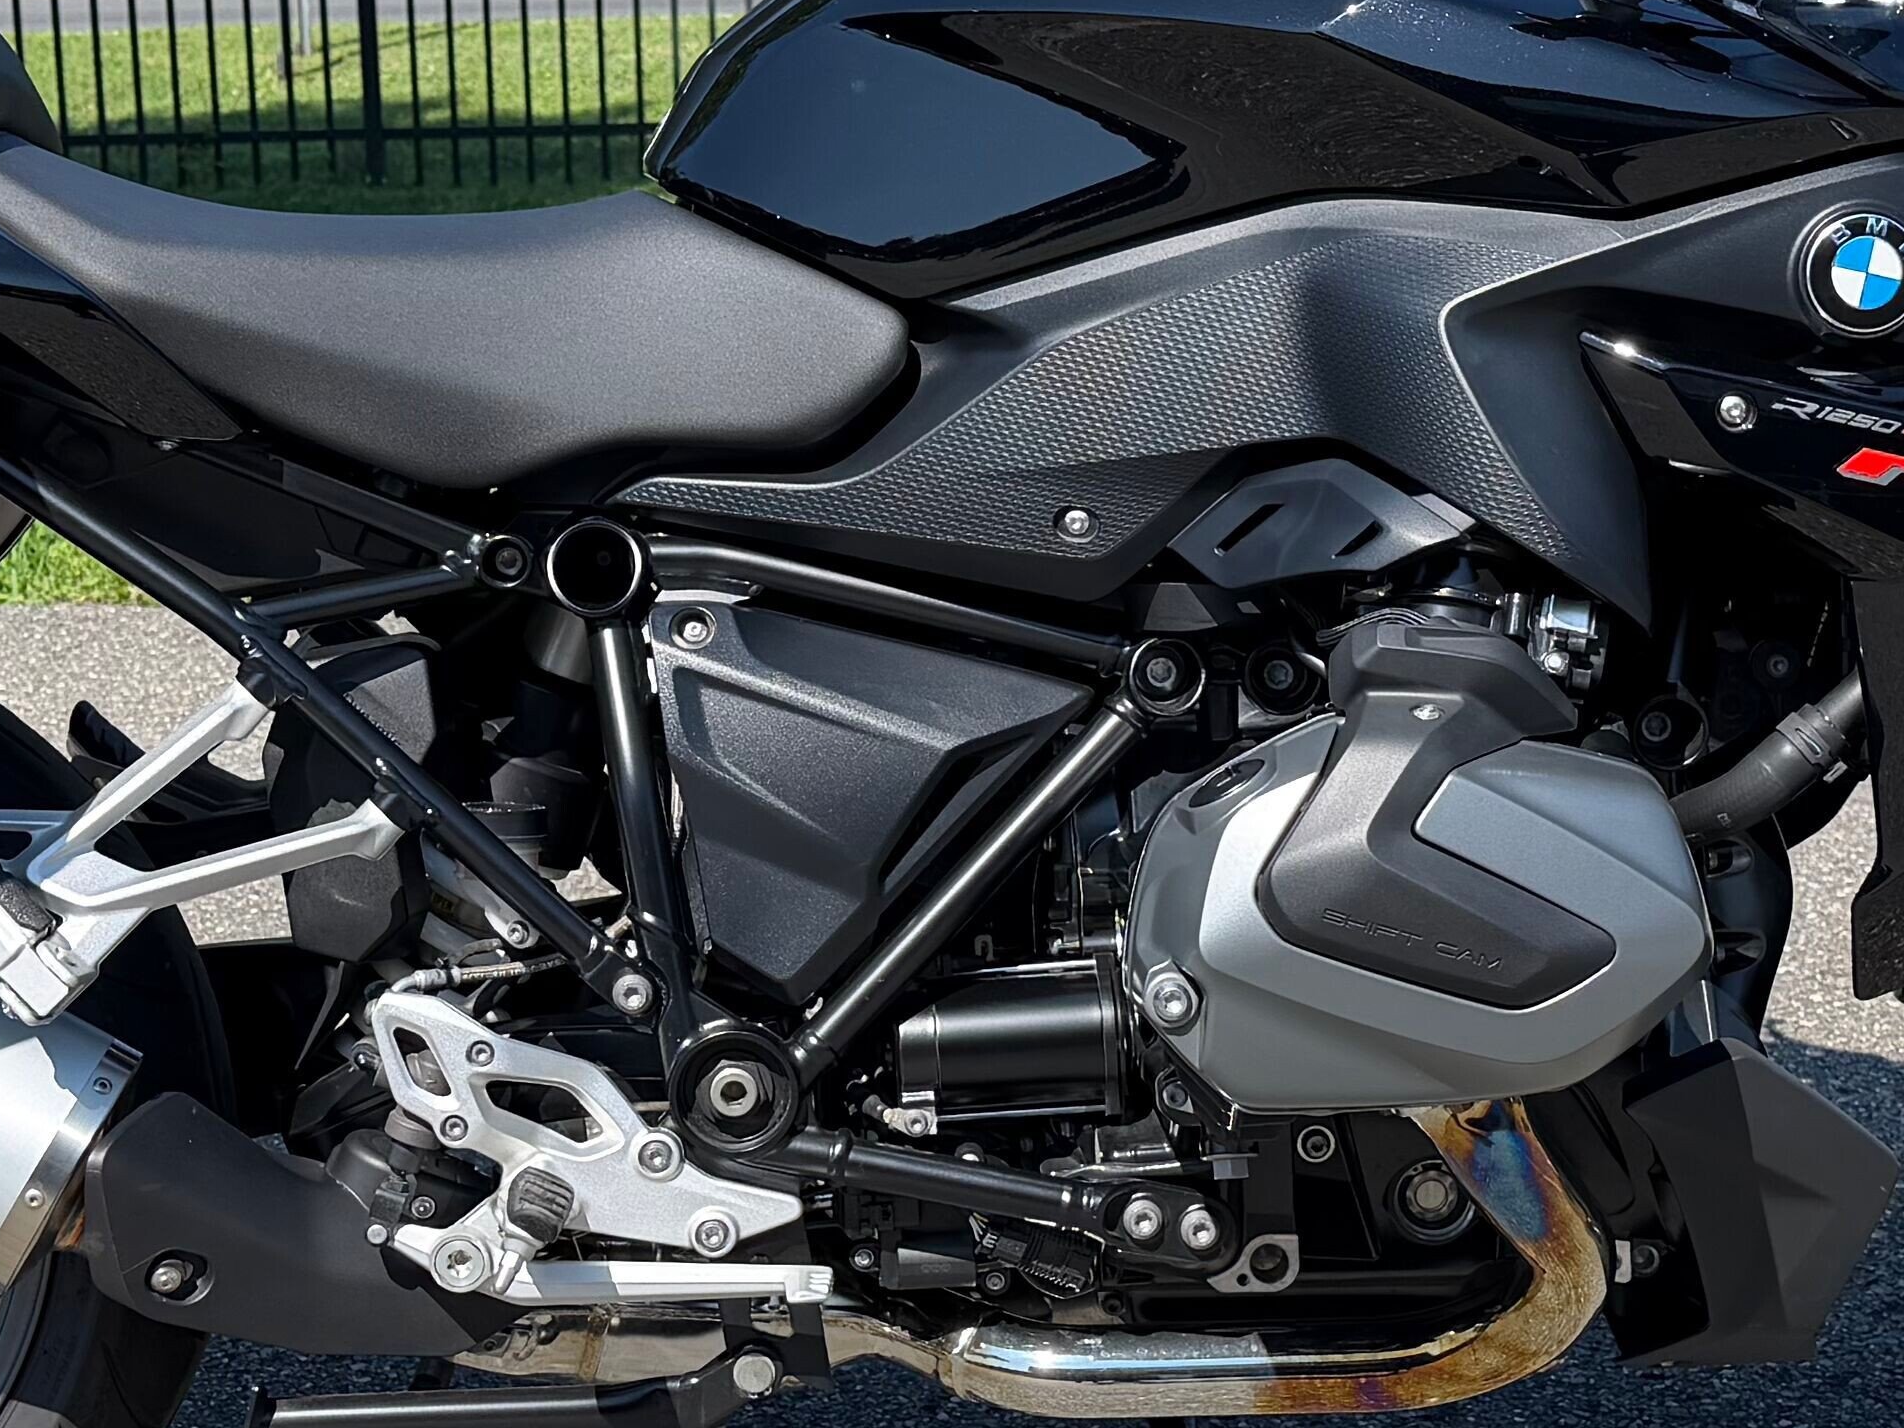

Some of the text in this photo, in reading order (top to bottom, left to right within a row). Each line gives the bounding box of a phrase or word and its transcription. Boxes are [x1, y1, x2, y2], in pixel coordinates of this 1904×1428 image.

[1771, 397, 1902, 434] R1250
[1322, 907, 1504, 972] SHIFT CAM
